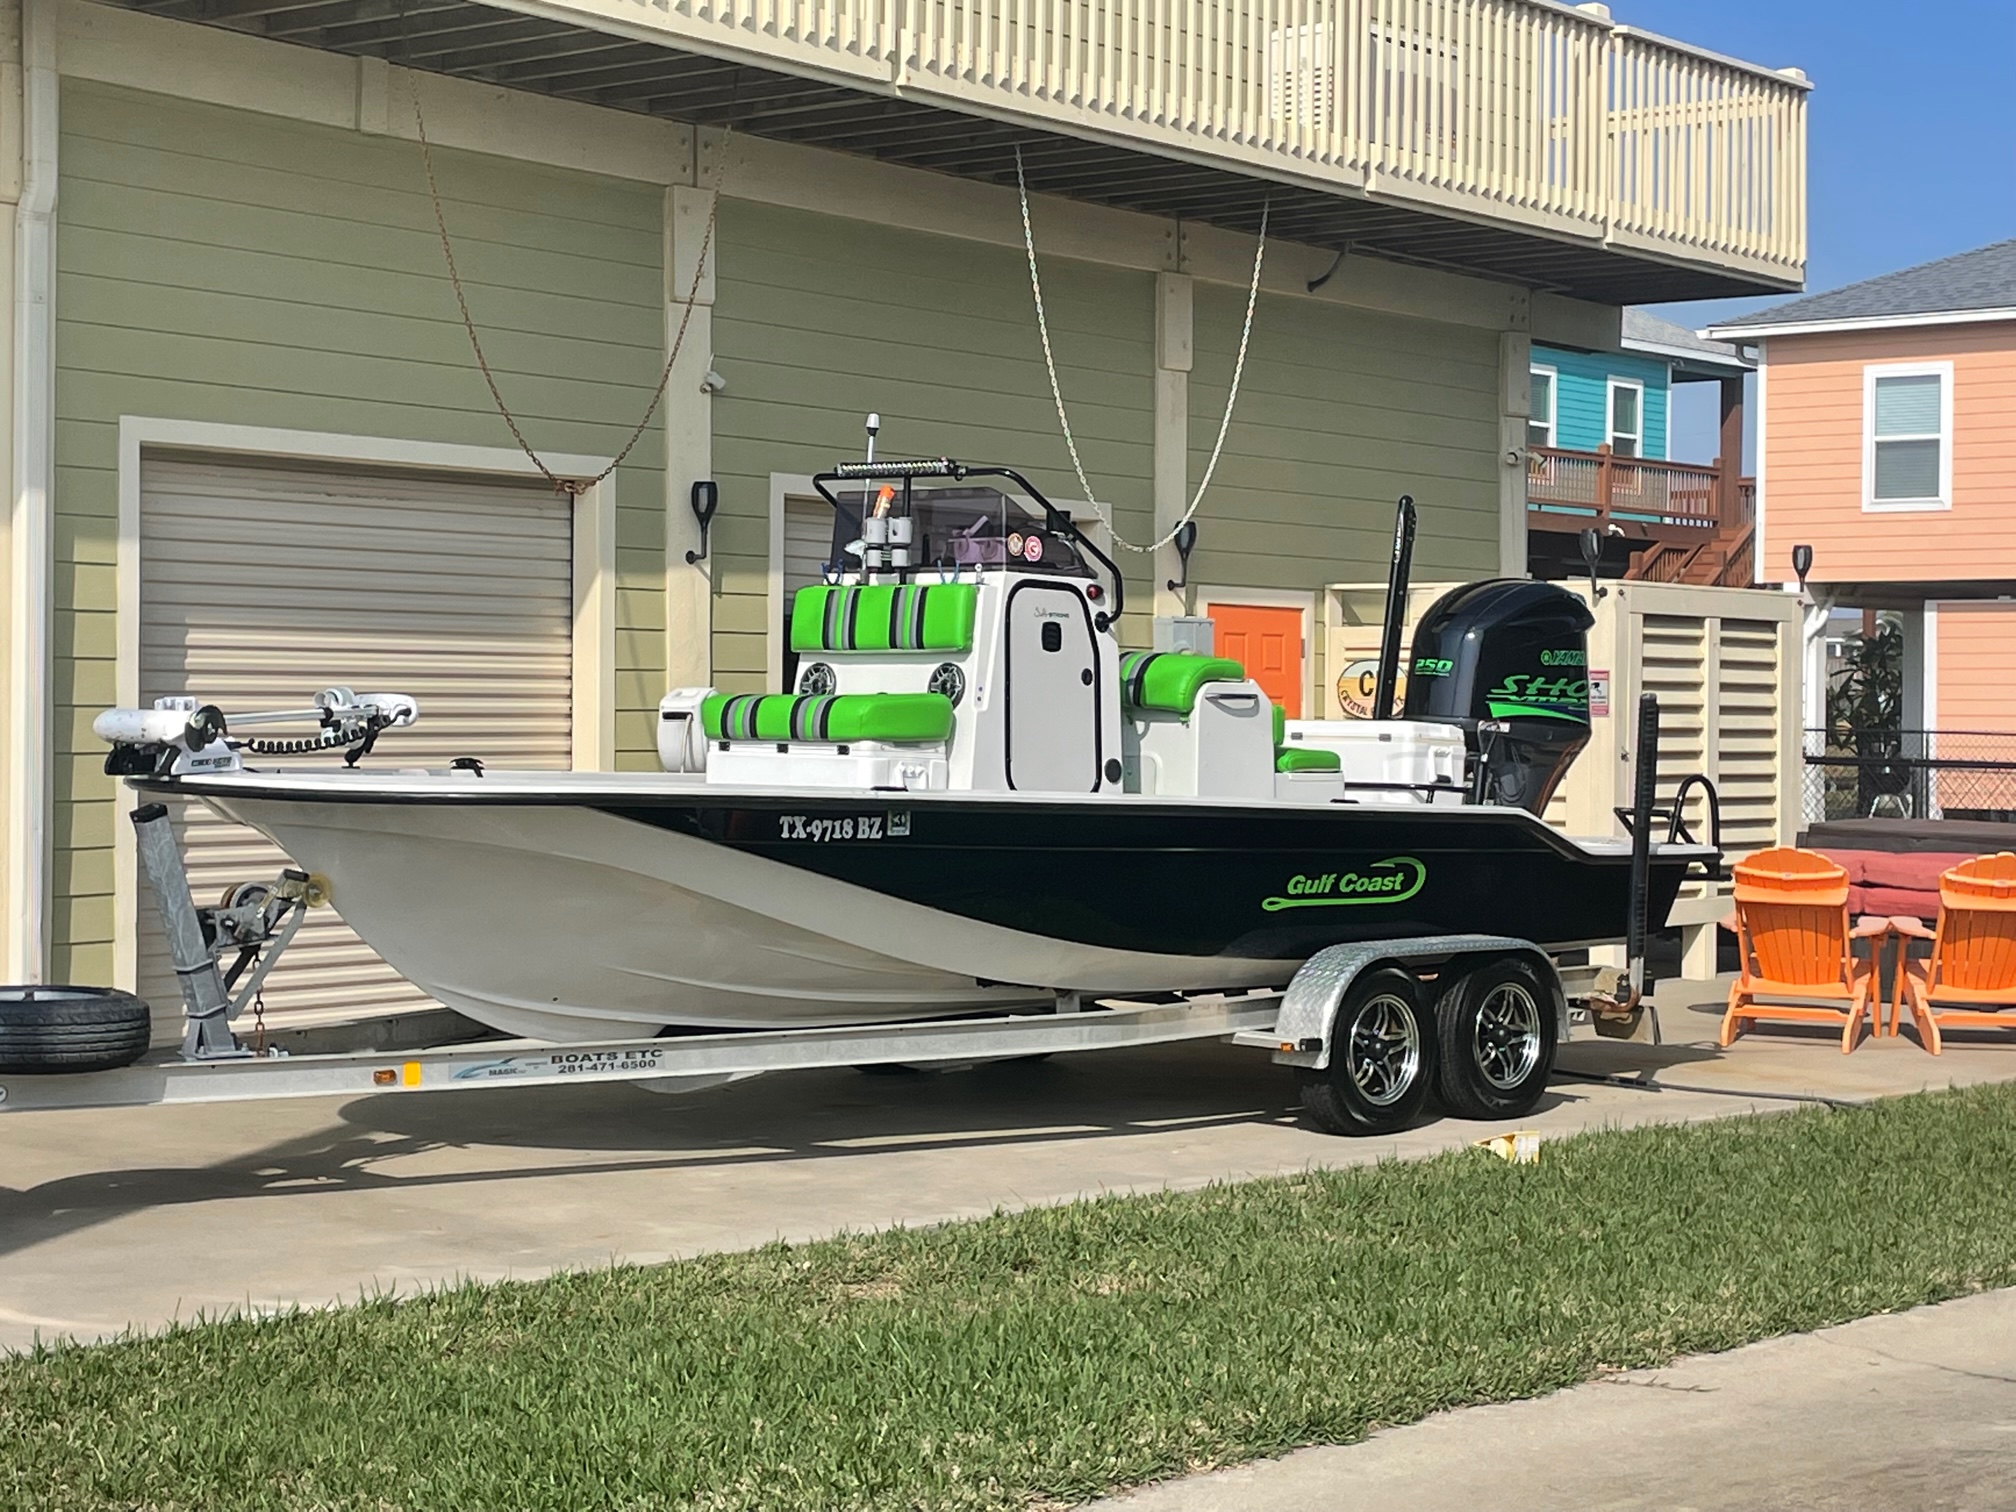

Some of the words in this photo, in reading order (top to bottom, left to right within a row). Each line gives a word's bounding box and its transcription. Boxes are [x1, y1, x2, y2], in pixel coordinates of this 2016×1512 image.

[1415, 658, 1453, 673] 250
[1490, 674, 1588, 697] SHO
[856, 816, 883, 840] BZ
[1287, 873, 1337, 895] Gulf
[1339, 872, 1404, 893] Coast
[551, 1050, 618, 1065] BOATS
[625, 1049, 663, 1060] ETC
[558, 1059, 656, 1074] 281-471-6500
